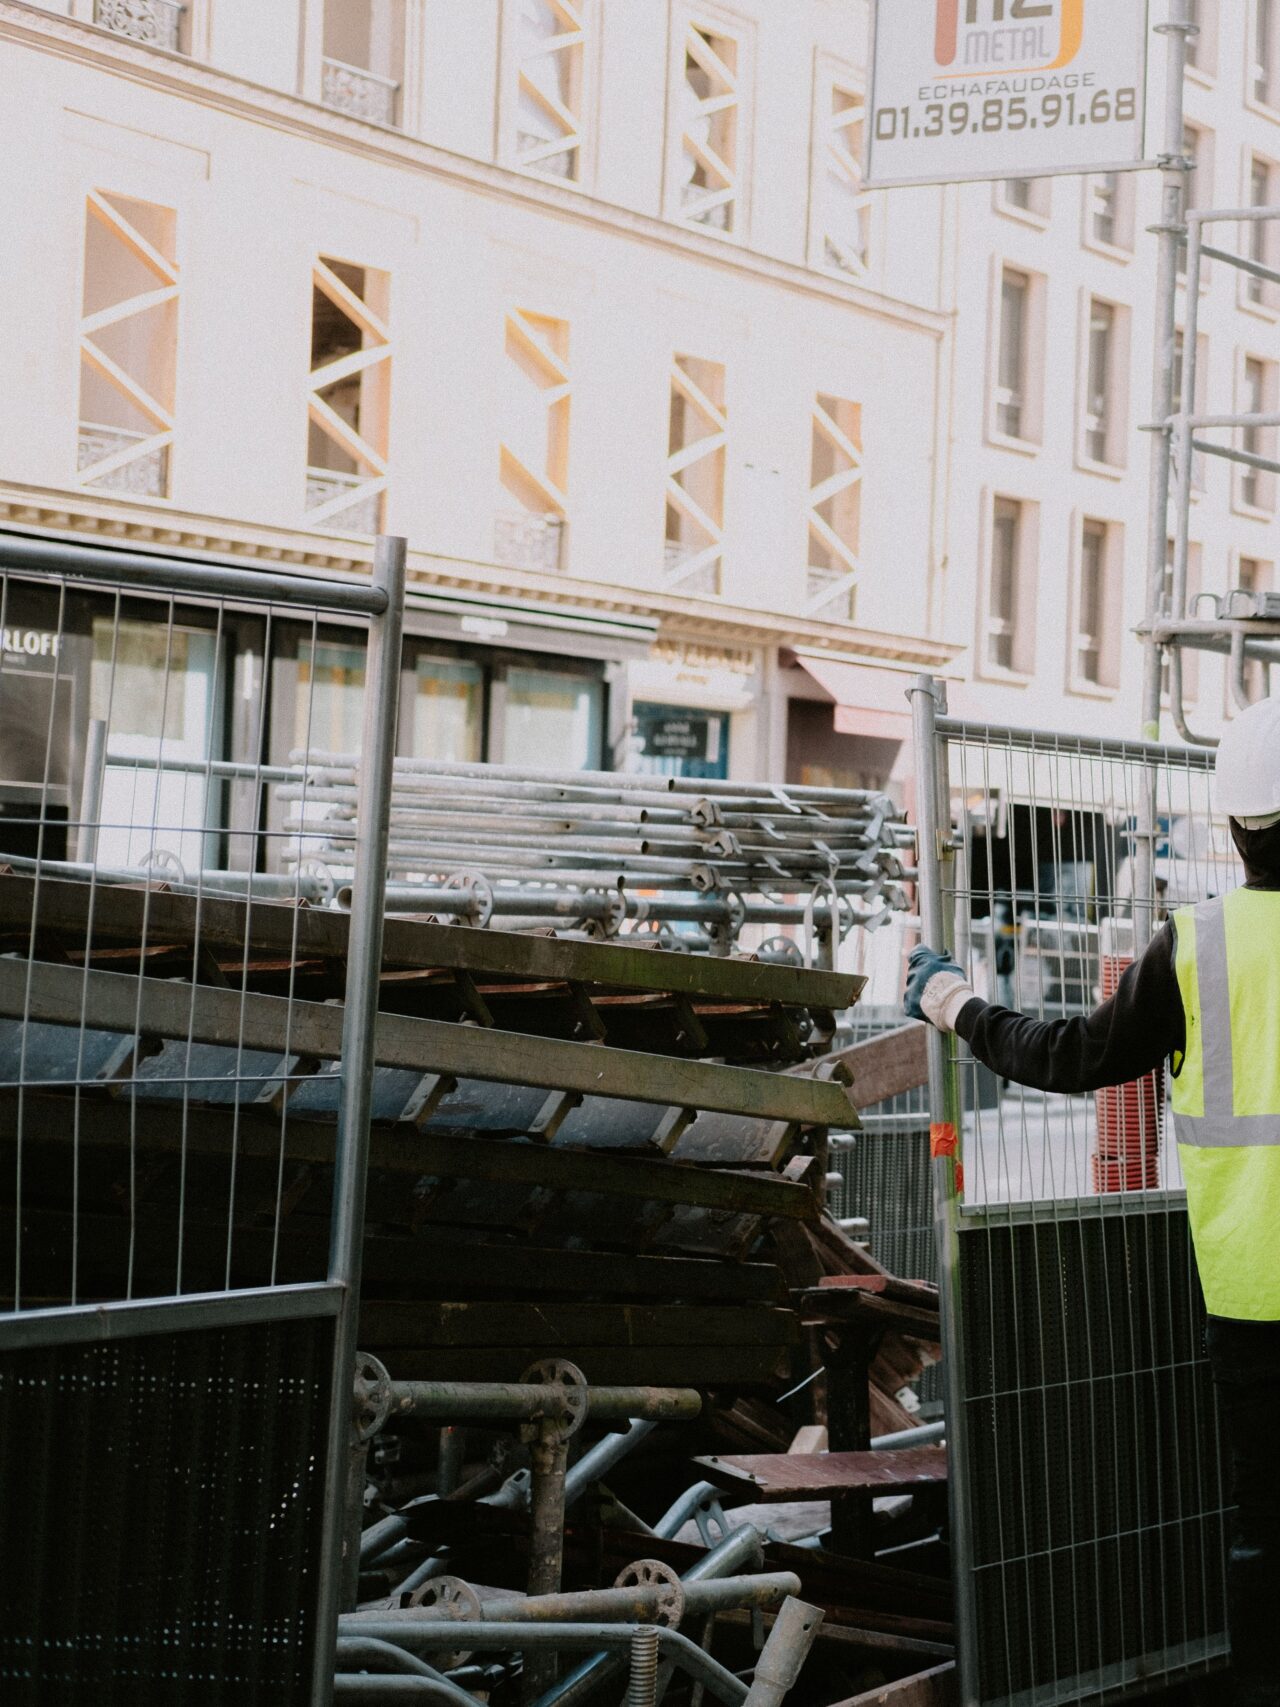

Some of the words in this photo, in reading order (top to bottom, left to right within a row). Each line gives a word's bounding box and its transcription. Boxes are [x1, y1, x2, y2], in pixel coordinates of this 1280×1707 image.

[964, 26, 1050, 64] METAL
[918, 73, 1095, 99] ECHAFAUDAGE
[876, 88, 1136, 140] 01.39.85.91.68
